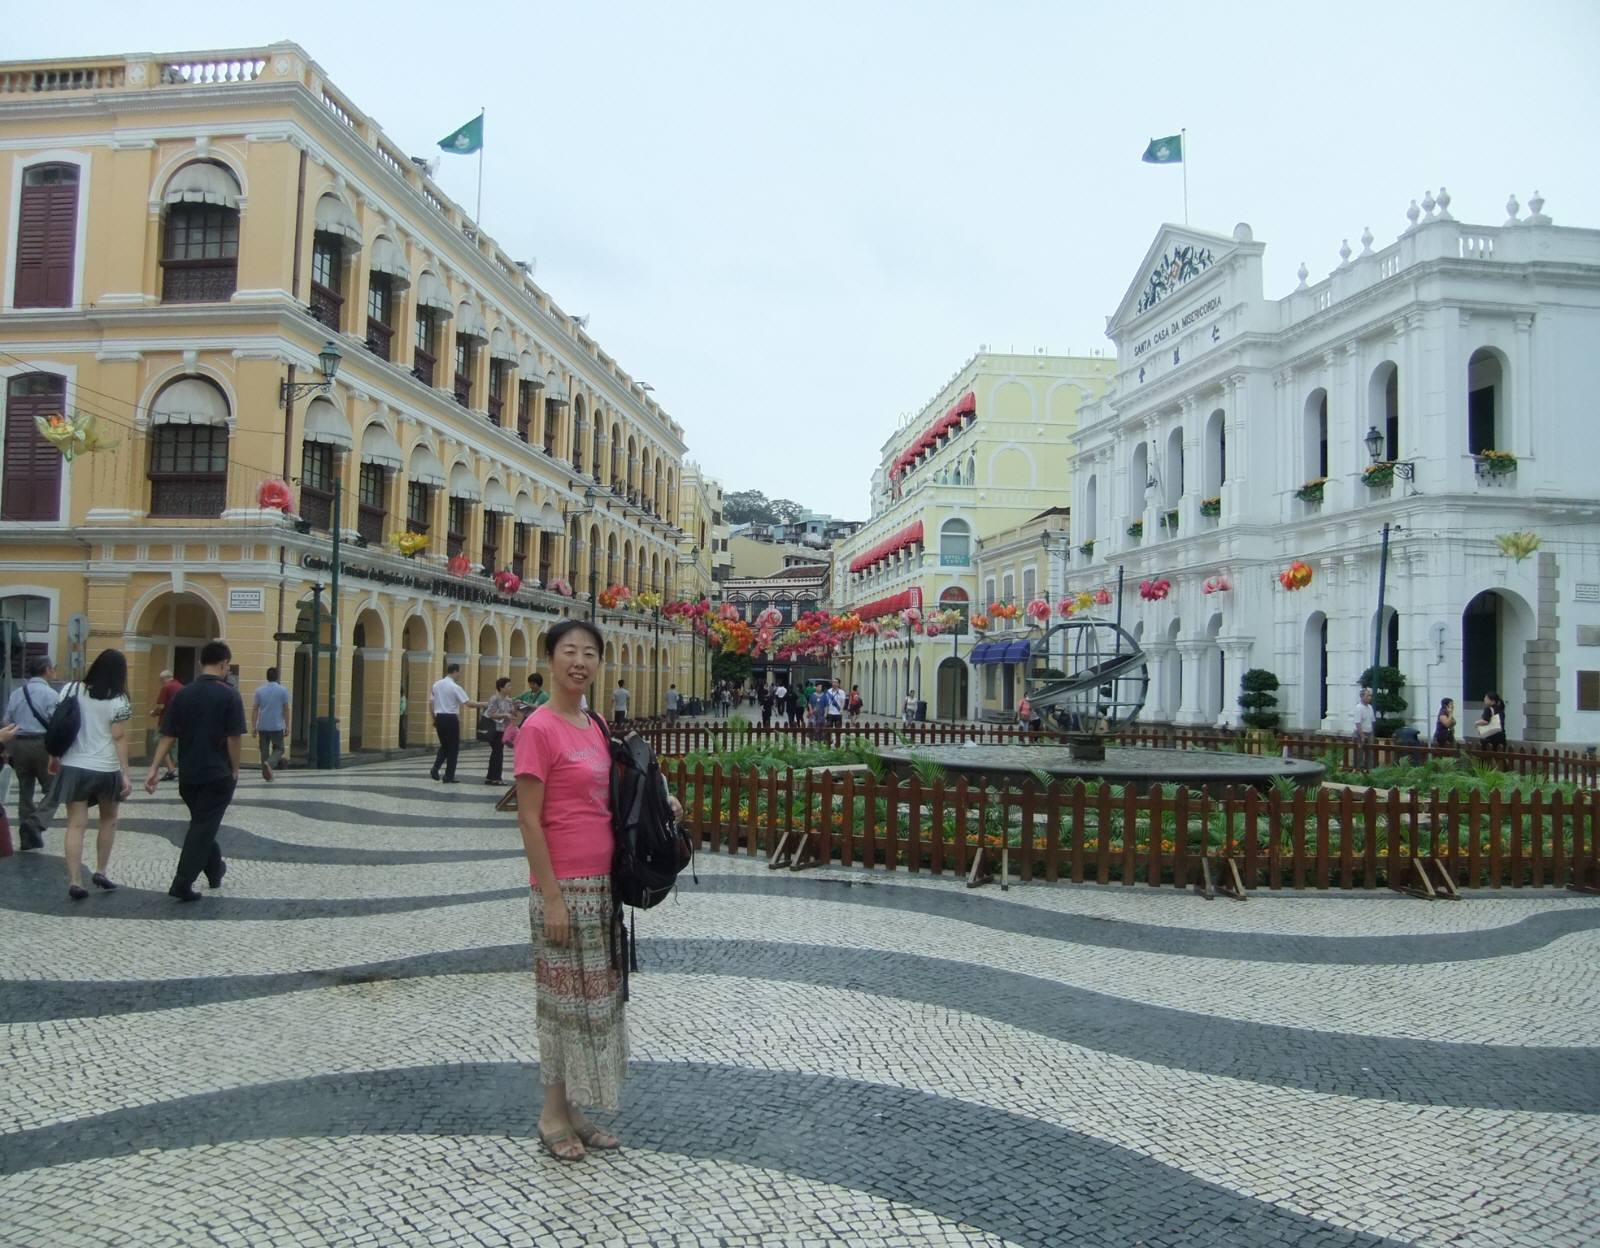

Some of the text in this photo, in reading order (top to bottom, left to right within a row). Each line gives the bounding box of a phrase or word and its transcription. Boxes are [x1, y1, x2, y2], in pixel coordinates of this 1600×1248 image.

[1134, 339, 1152, 357] SANTA
[1153, 327, 1170, 344] CASA
[1172, 321, 1180, 335] DA
